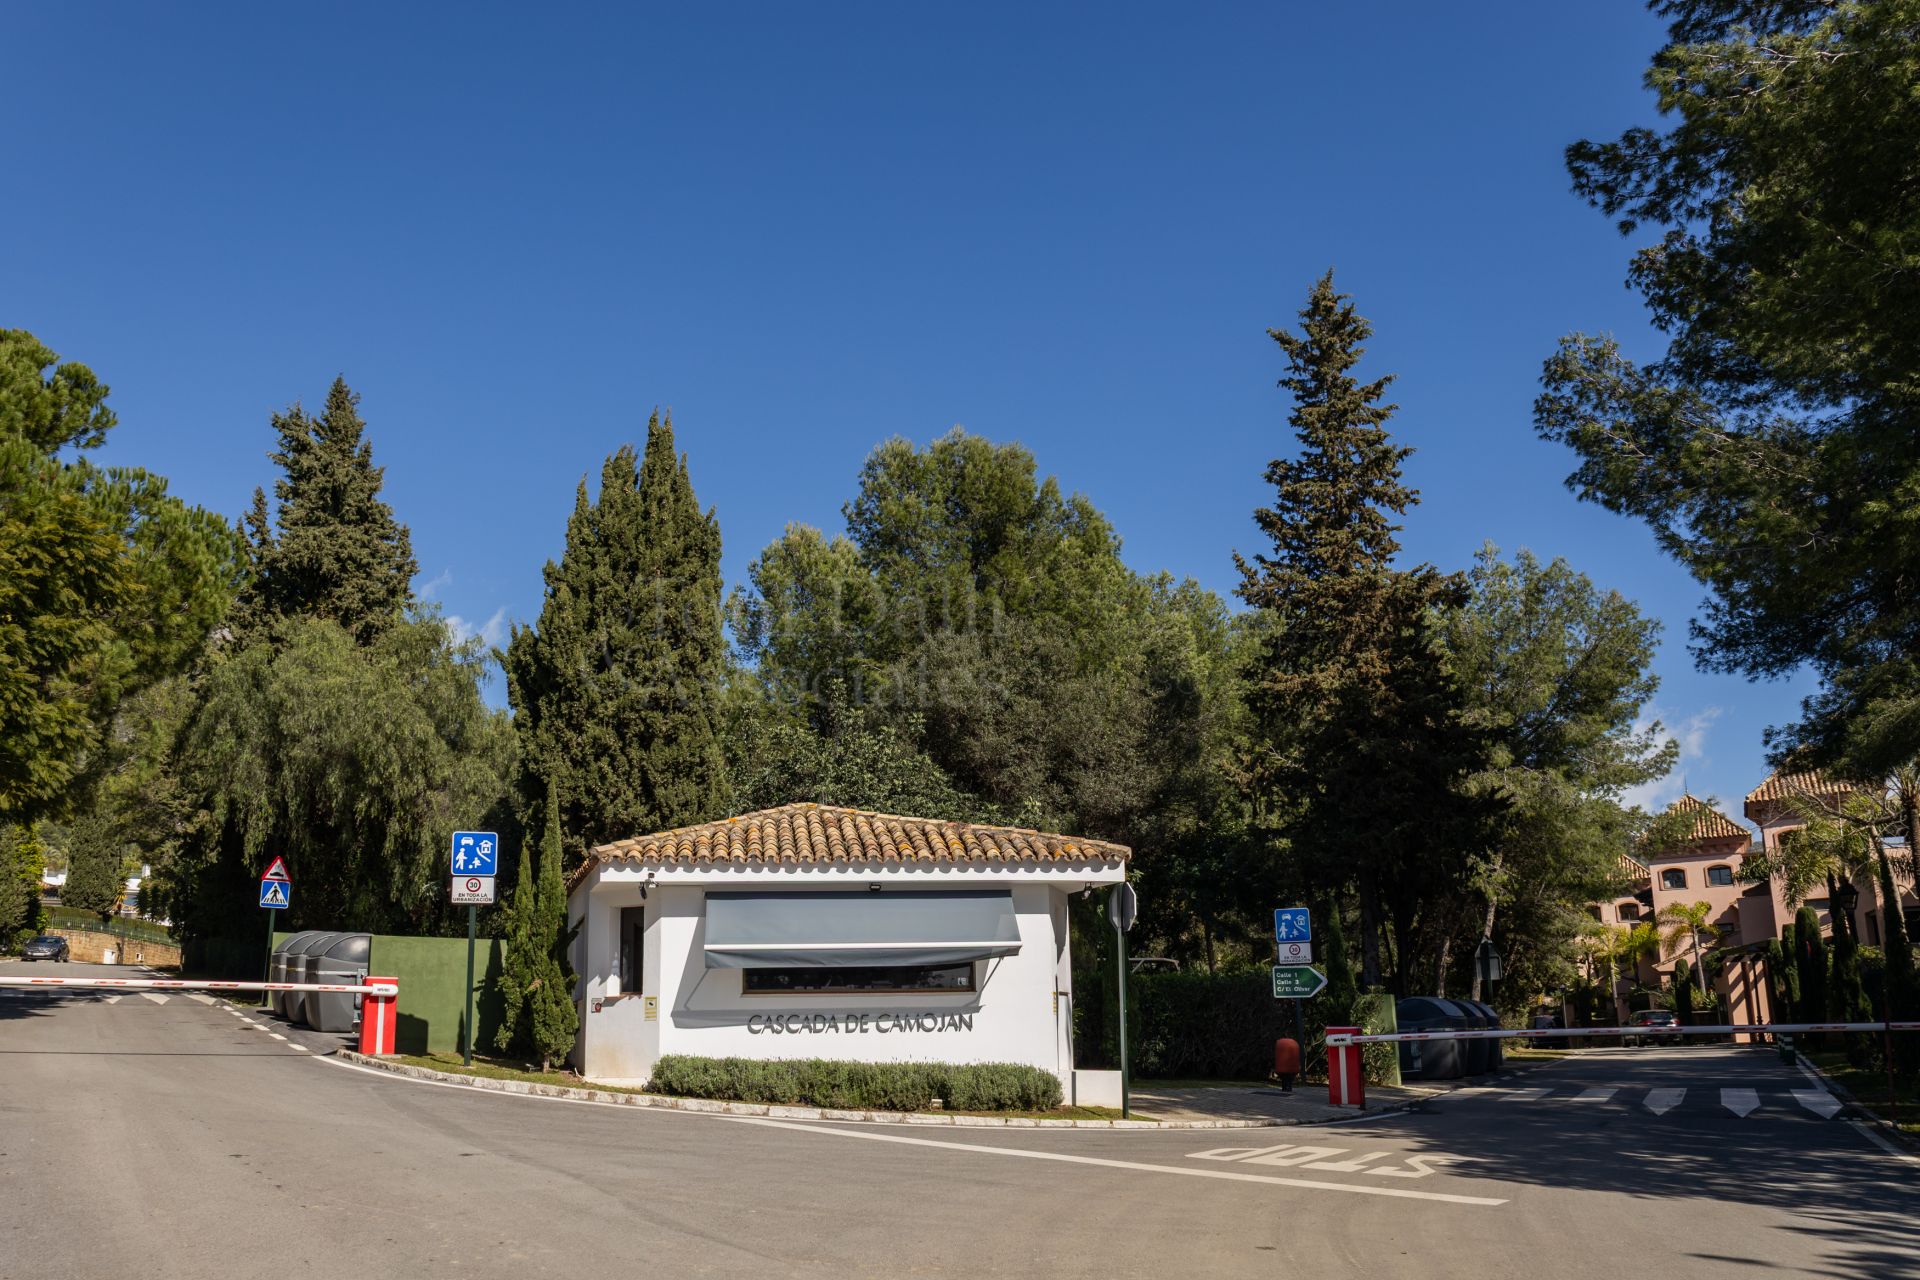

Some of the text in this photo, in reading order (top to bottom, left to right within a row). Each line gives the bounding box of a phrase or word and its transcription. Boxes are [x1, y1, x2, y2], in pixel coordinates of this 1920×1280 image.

[747, 1012, 973, 1034] CASCADA DE CAMOJAN
[1184, 1143, 1490, 1179] STOP
